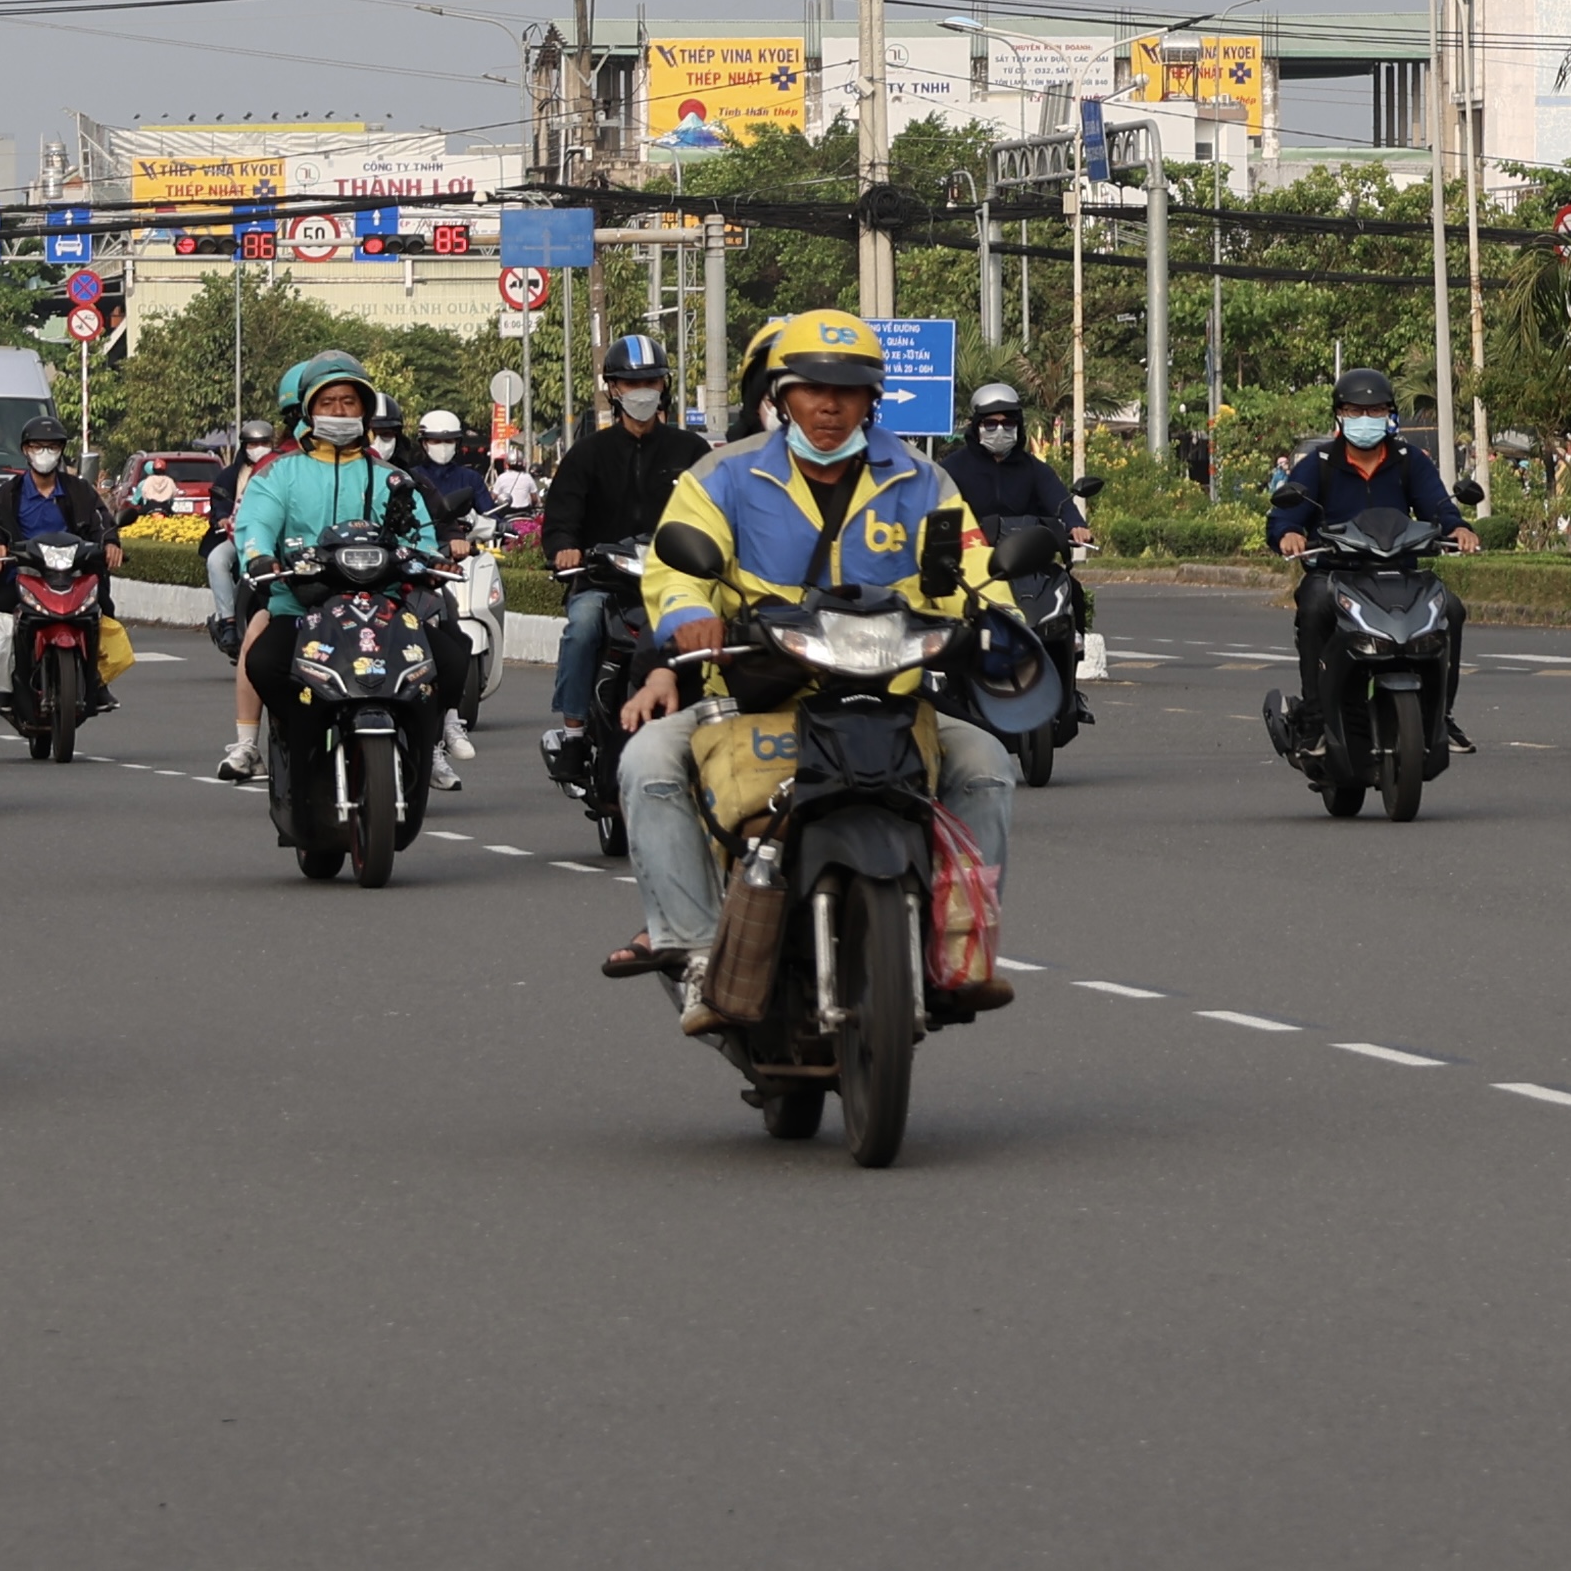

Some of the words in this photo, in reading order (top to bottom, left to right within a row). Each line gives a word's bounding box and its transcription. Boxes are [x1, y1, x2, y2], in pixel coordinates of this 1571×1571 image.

[679, 46, 714, 63] THÉP
[721, 48, 752, 63] VINA
[759, 48, 799, 63] KYOEI
[1224, 46, 1255, 59] KYOEI
[686, 69, 721, 86] THÉP
[728, 69, 763, 88] NHẬT
[888, 82, 905, 93] TY
[911, 82, 950, 93] TNHH
[240, 163, 283, 177] KYOEI
[363, 161, 393, 171] CÔNG
[397, 162, 410, 171] TY
[414, 162, 444, 171] TNHH
[165, 182, 204, 197] THÉP
[303, 226, 325, 248] 50
[435, 227, 467, 254] 85
[244, 234, 274, 259] 86
[819, 323, 859, 345] be
[887, 335, 908, 347] QUẬN
[892, 350, 901, 360] XE
[865, 509, 908, 552] be
[752, 727, 798, 761] be
